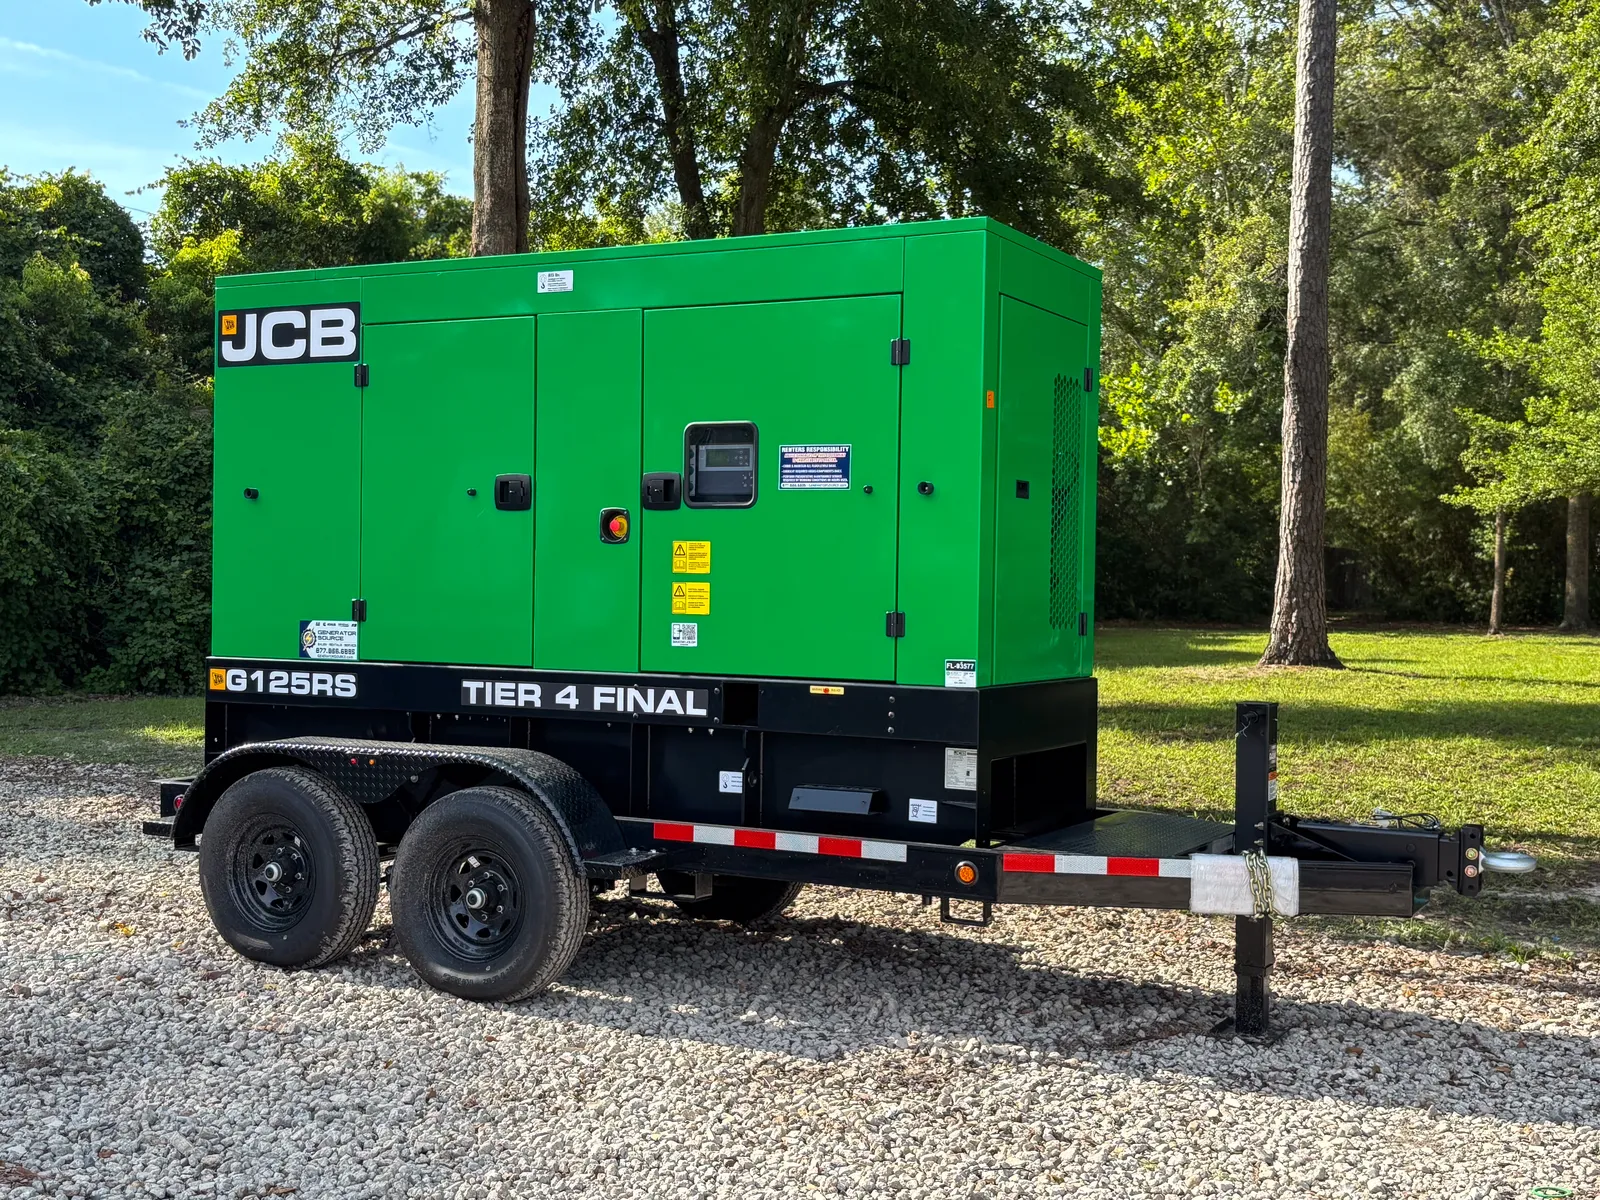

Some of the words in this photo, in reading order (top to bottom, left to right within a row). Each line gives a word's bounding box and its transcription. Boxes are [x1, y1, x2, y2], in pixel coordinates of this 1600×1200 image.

[222, 308, 357, 362] JCB
[226, 668, 357, 697] G125RS
[462, 681, 542, 707] TIER
[555, 685, 580, 709] 4
[593, 686, 707, 716] FINAL
